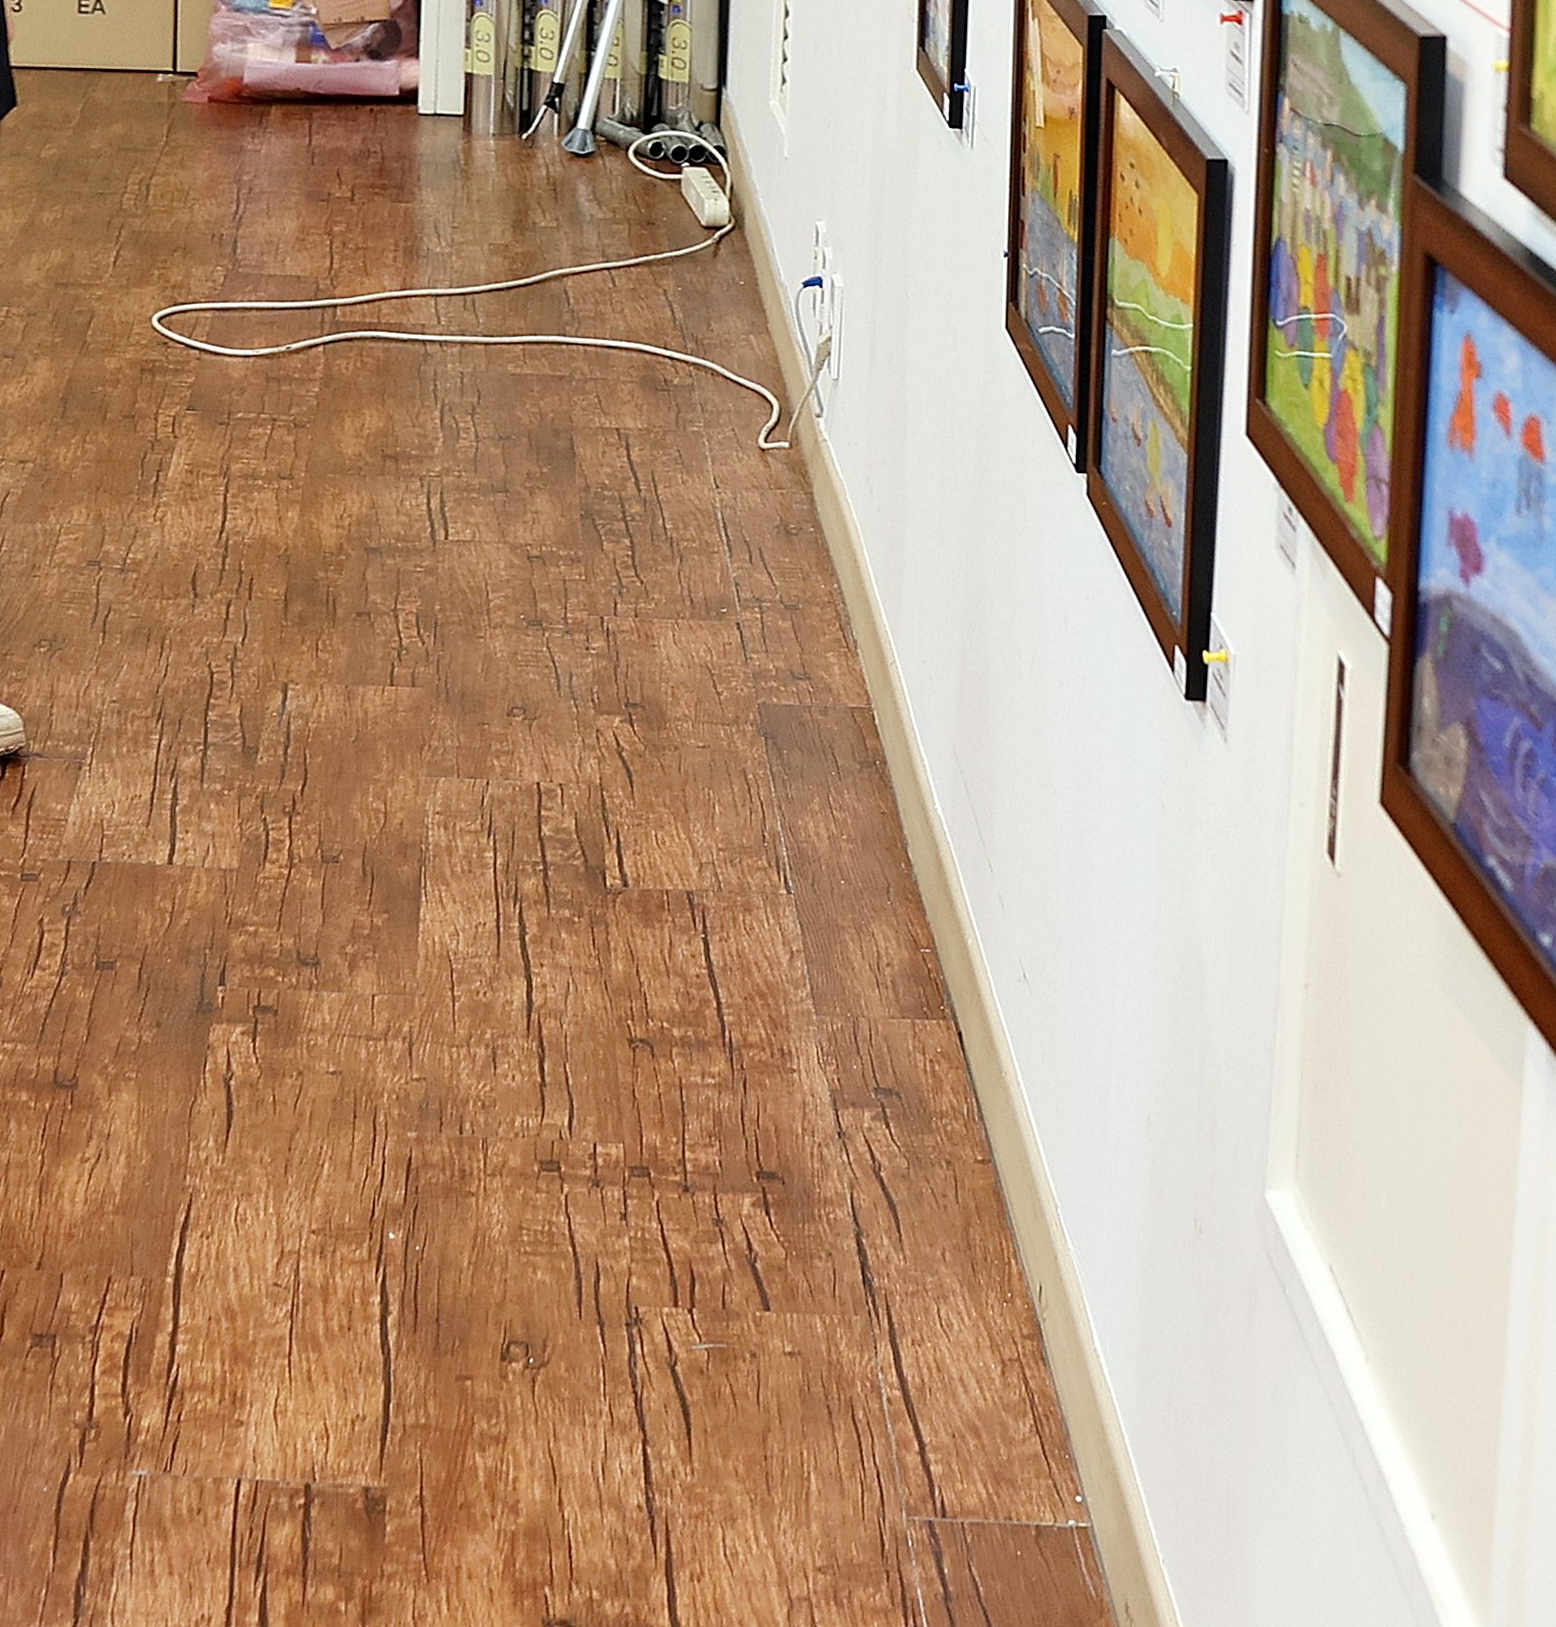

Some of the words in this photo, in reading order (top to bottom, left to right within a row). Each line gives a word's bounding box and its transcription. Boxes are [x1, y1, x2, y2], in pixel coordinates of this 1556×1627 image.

[475, 29, 491, 63] 3.0
[539, 27, 554, 61] 3.0
[671, 36, 687, 71] 3.0
